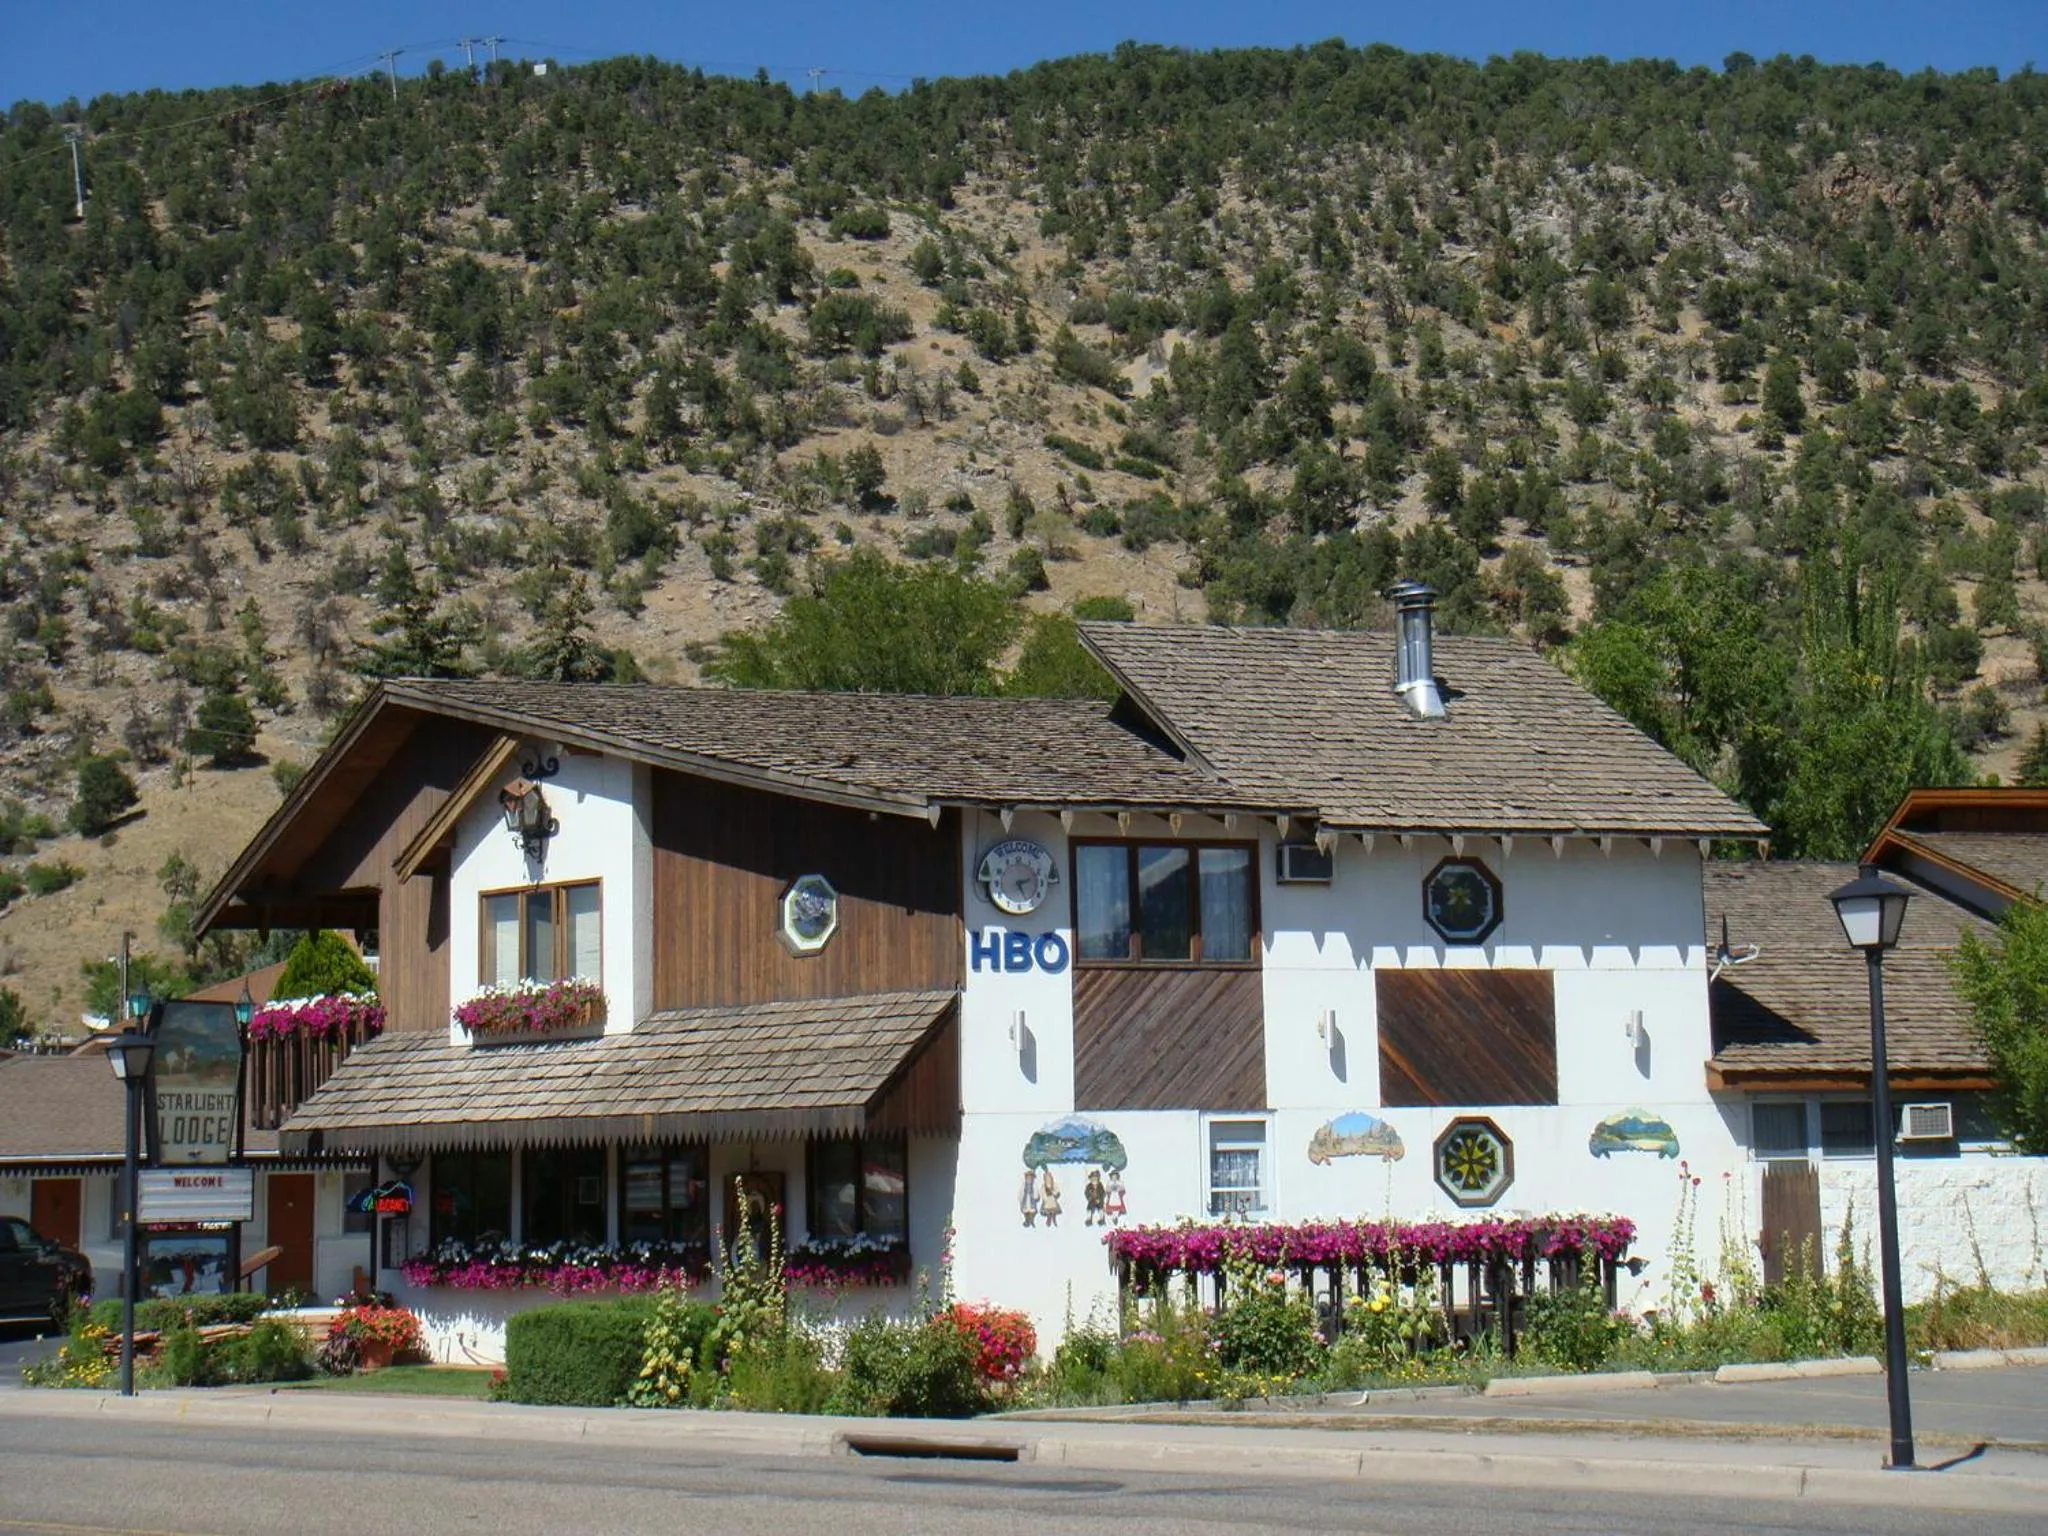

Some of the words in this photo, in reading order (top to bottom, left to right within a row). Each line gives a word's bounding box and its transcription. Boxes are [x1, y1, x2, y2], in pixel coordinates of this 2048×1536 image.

[994, 842, 1043, 859] WELCOME
[971, 931, 1070, 974] HBO
[157, 1094, 233, 1110] STARLIGHT
[159, 1116, 228, 1144] LODGE
[174, 1175, 223, 1187] WELCOME
